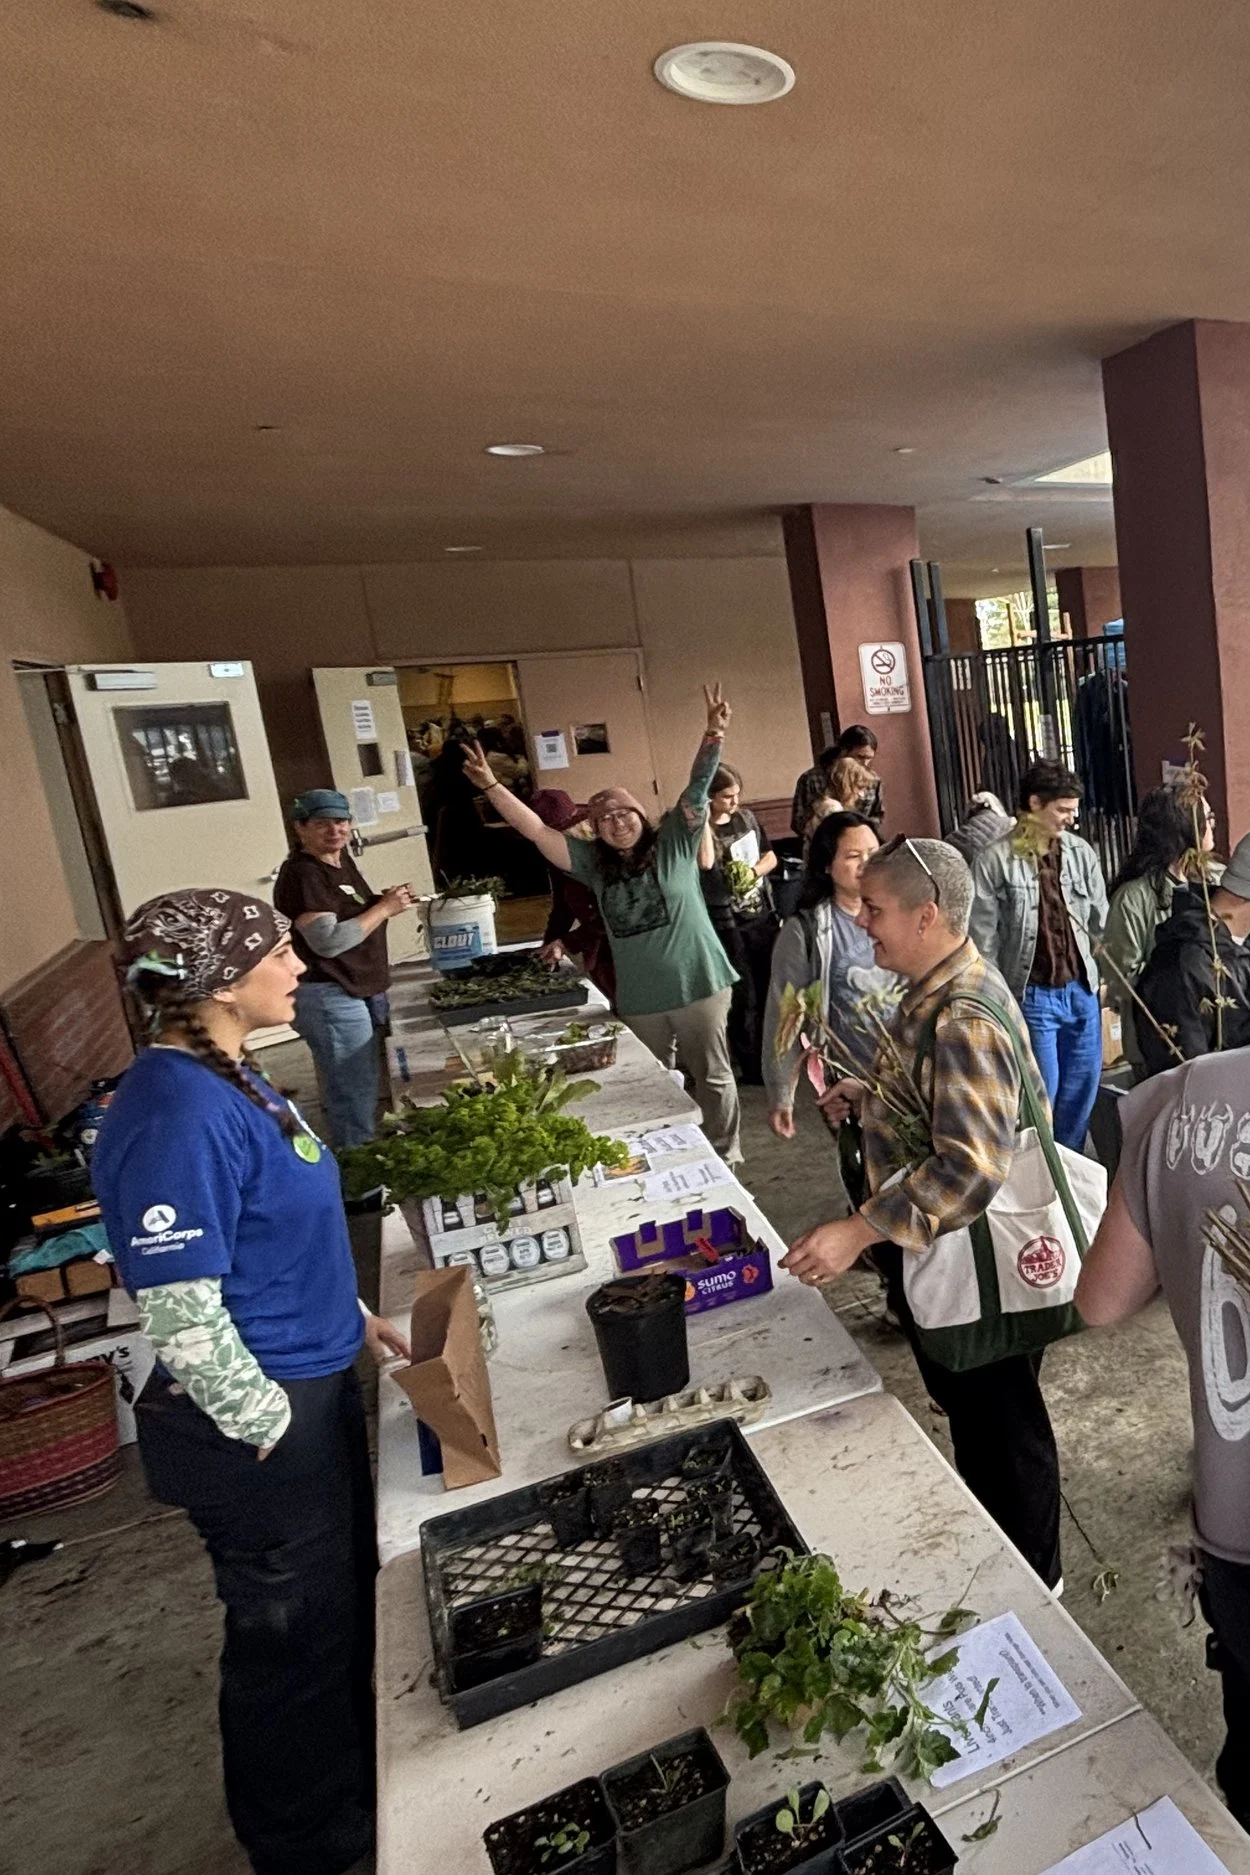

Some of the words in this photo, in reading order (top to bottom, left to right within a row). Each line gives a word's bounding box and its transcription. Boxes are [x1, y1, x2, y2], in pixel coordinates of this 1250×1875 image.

[879, 675, 892, 686] NO
[869, 686, 904, 697] SMOKING
[131, 1228, 203, 1247] AmeriCorps
[1024, 1258, 1061, 1274] TRADER
[701, 1281, 734, 1295] CITRUS
